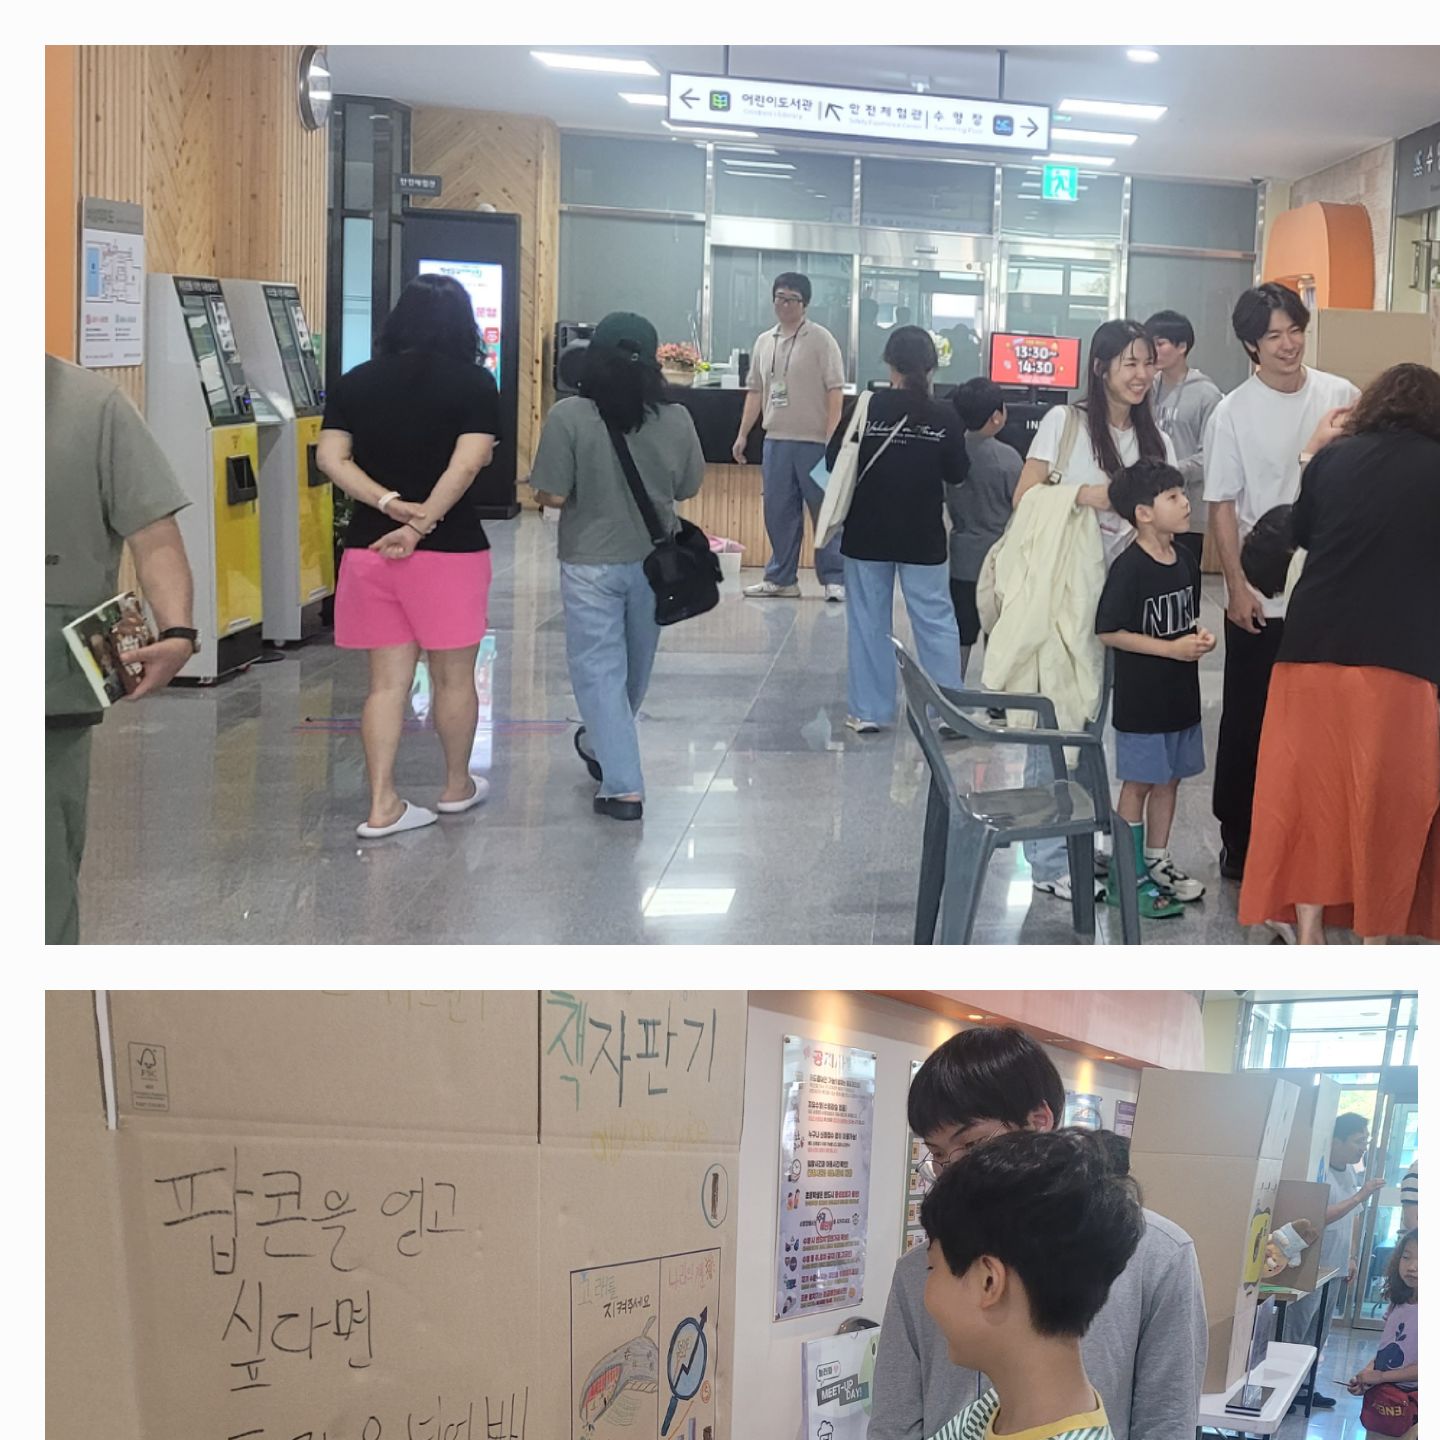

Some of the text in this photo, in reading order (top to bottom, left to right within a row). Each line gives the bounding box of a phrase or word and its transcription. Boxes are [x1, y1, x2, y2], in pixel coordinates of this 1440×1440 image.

[741, 93, 813, 111] 어린이도서관
[1018, 361, 1053, 374] 14:30
[153, 1146, 356, 1276] 팝콘을
[603, 1295, 651, 1319] 지켜주세요
[220, 1279, 373, 1392] 싶다면
[821, 1379, 854, 1402] MEET-UP
